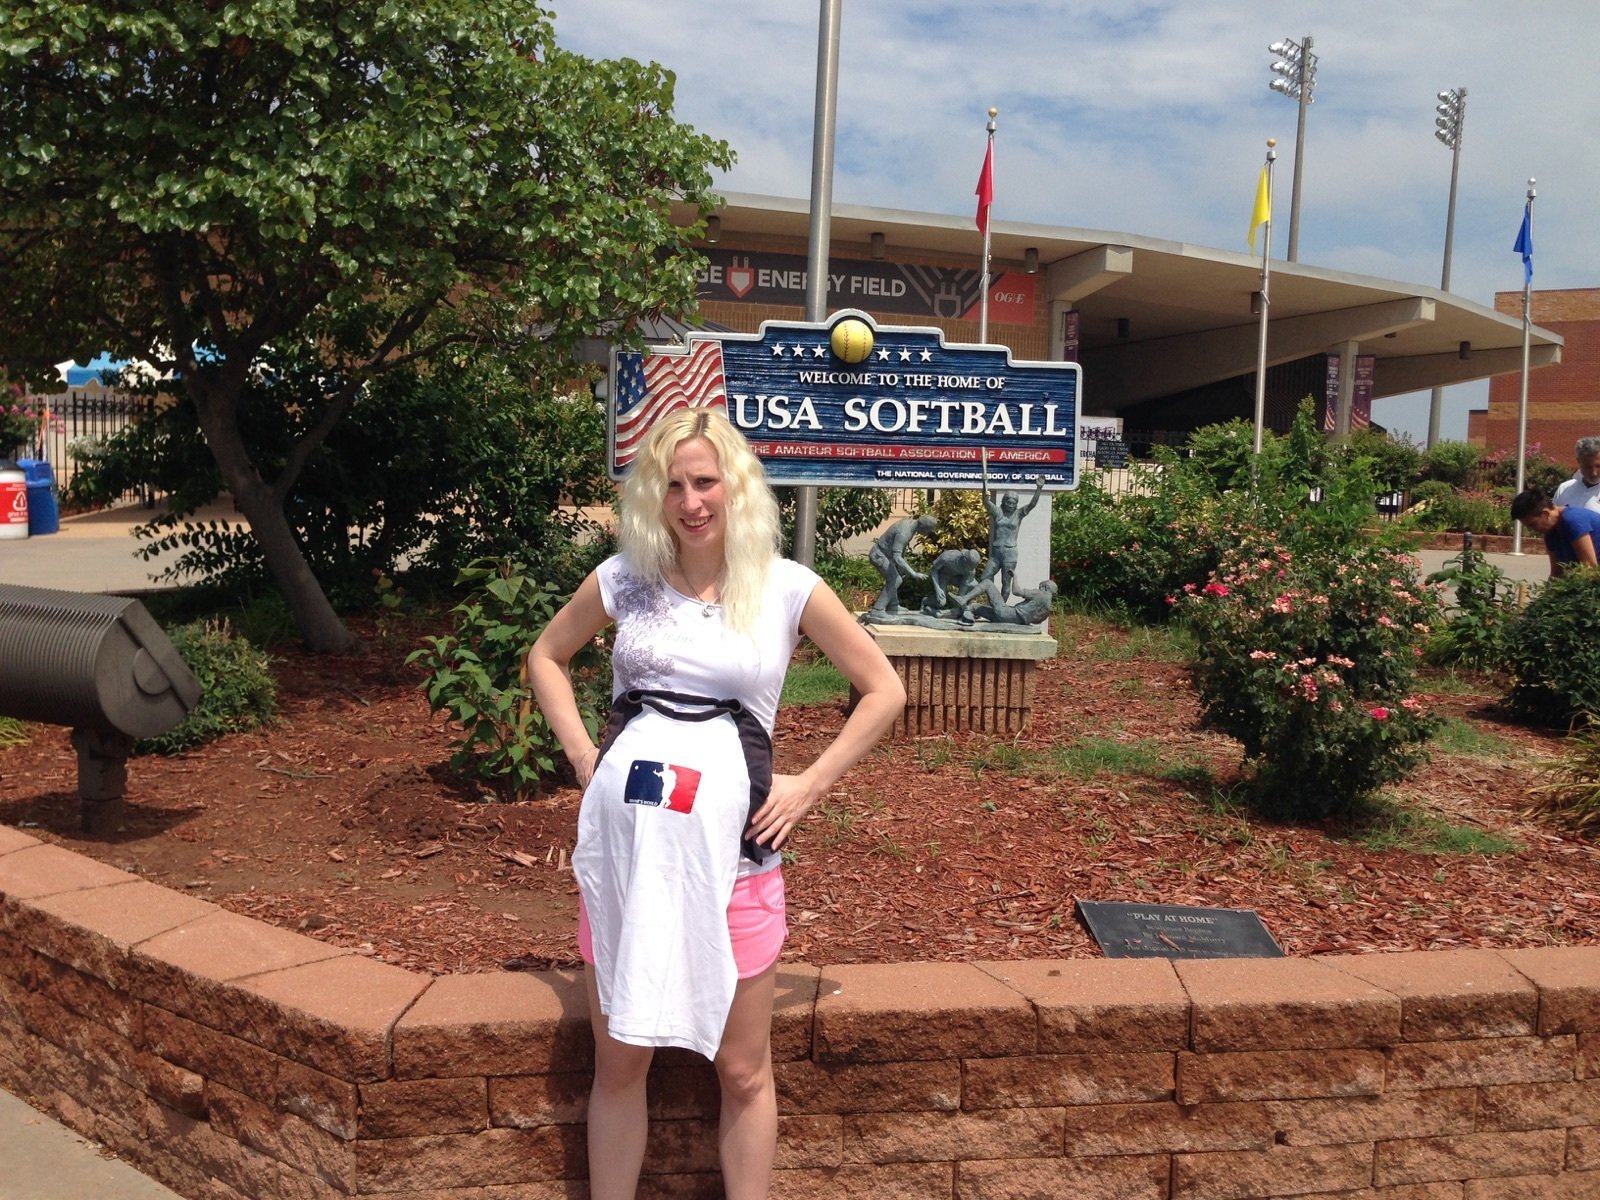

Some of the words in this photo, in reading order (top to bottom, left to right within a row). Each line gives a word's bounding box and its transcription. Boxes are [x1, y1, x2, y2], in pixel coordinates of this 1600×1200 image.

[758, 269, 846, 293] ENEY
[850, 275, 907, 297] FIELD
[799, 371, 872, 385] WELCOME
[877, 373, 899, 386] TO
[903, 374, 932, 387] THE
[937, 375, 981, 389] HOME
[985, 376, 1006, 389] OF
[732, 394, 823, 430] USA
[843, 397, 1067, 436] SOFTBALL
[748, 444, 770, 454] THE
[774, 445, 832, 456] AMATEUR
[836, 446, 896, 457] SOFTBALL
[900, 448, 976, 459] ASSOCIATION
[999, 451, 1051, 460] AMERICA
[894, 470, 935, 478] NATIONAL
[1164, 914, 1177, 922] AT
